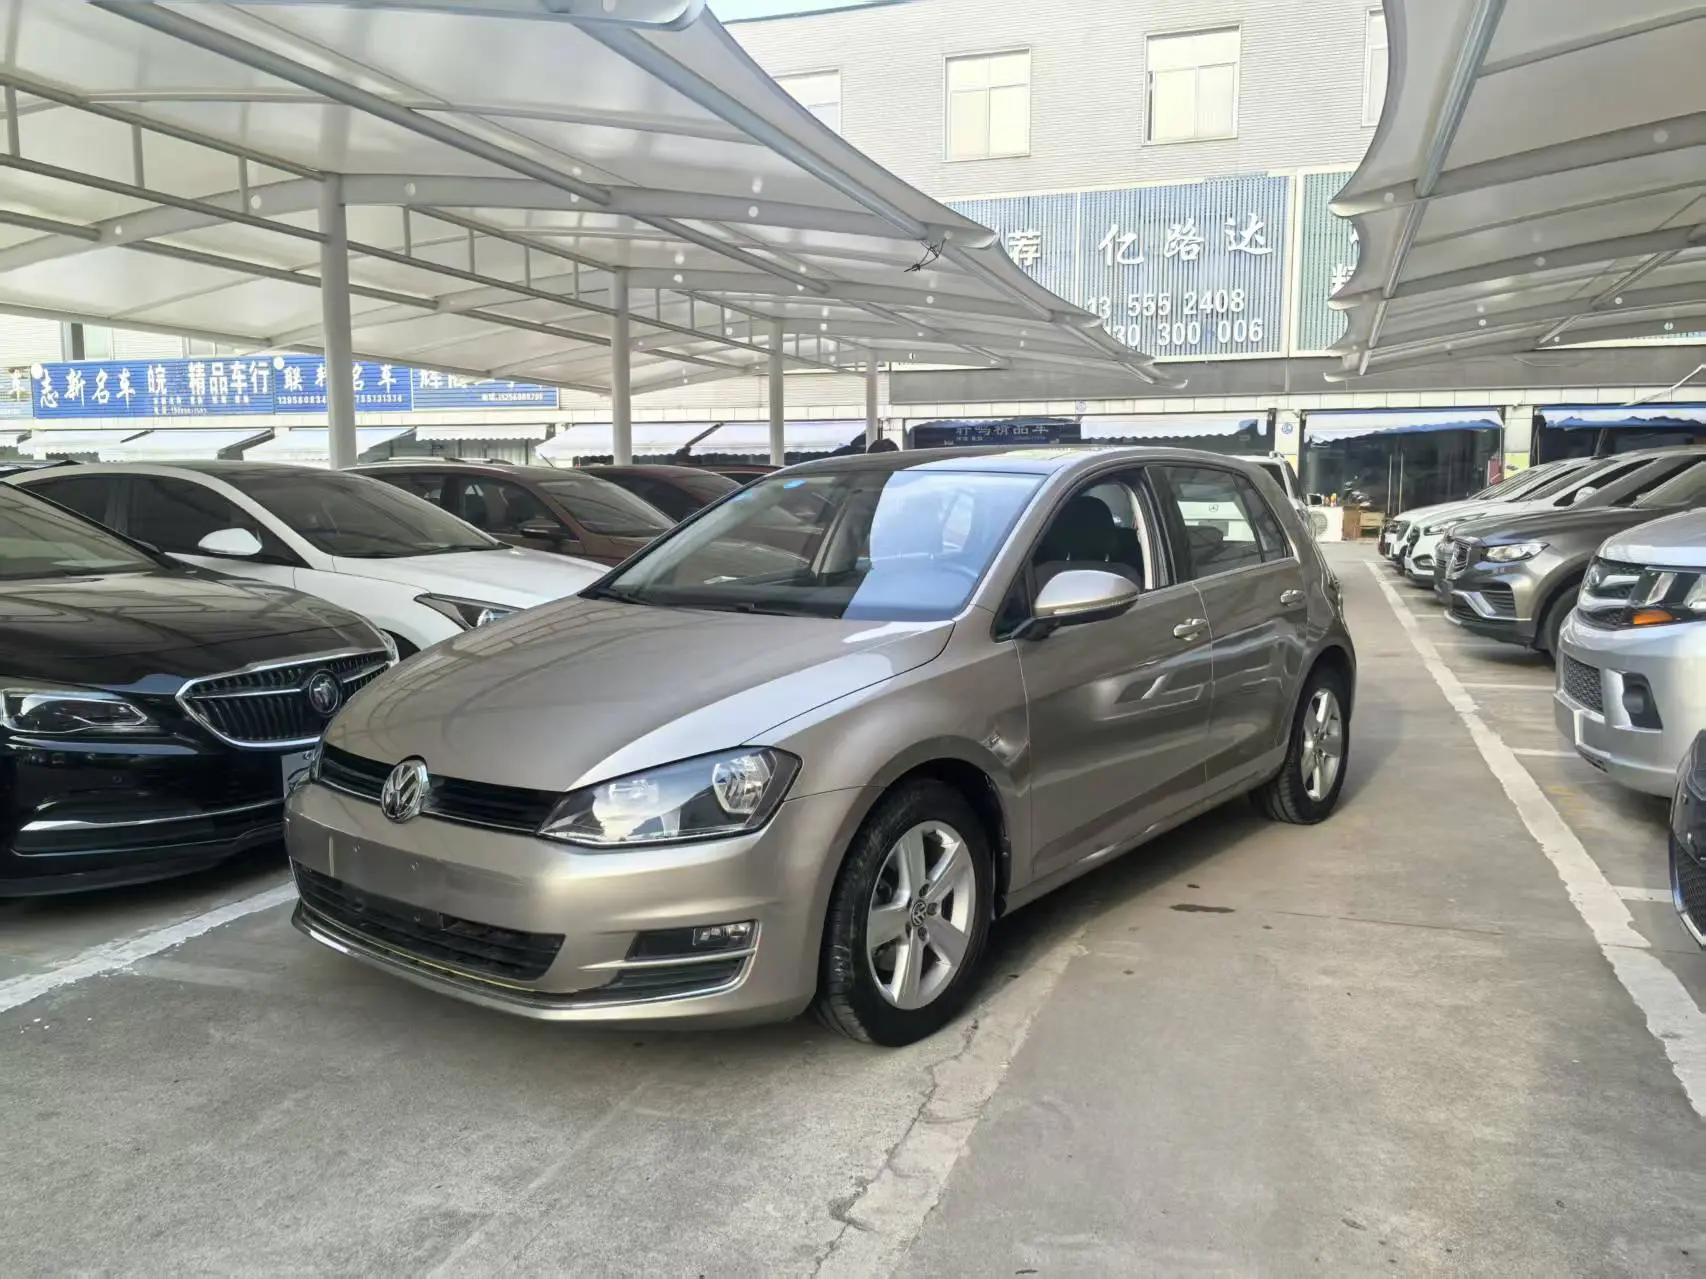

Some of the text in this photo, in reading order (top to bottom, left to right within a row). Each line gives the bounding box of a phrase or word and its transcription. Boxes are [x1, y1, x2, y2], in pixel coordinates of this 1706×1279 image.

[1099, 213, 1273, 266] 亿路达
[1127, 292, 1171, 316] 555
[1183, 289, 1245, 314] 2408
[1157, 321, 1201, 345] 300
[1217, 318, 1263, 342] 006
